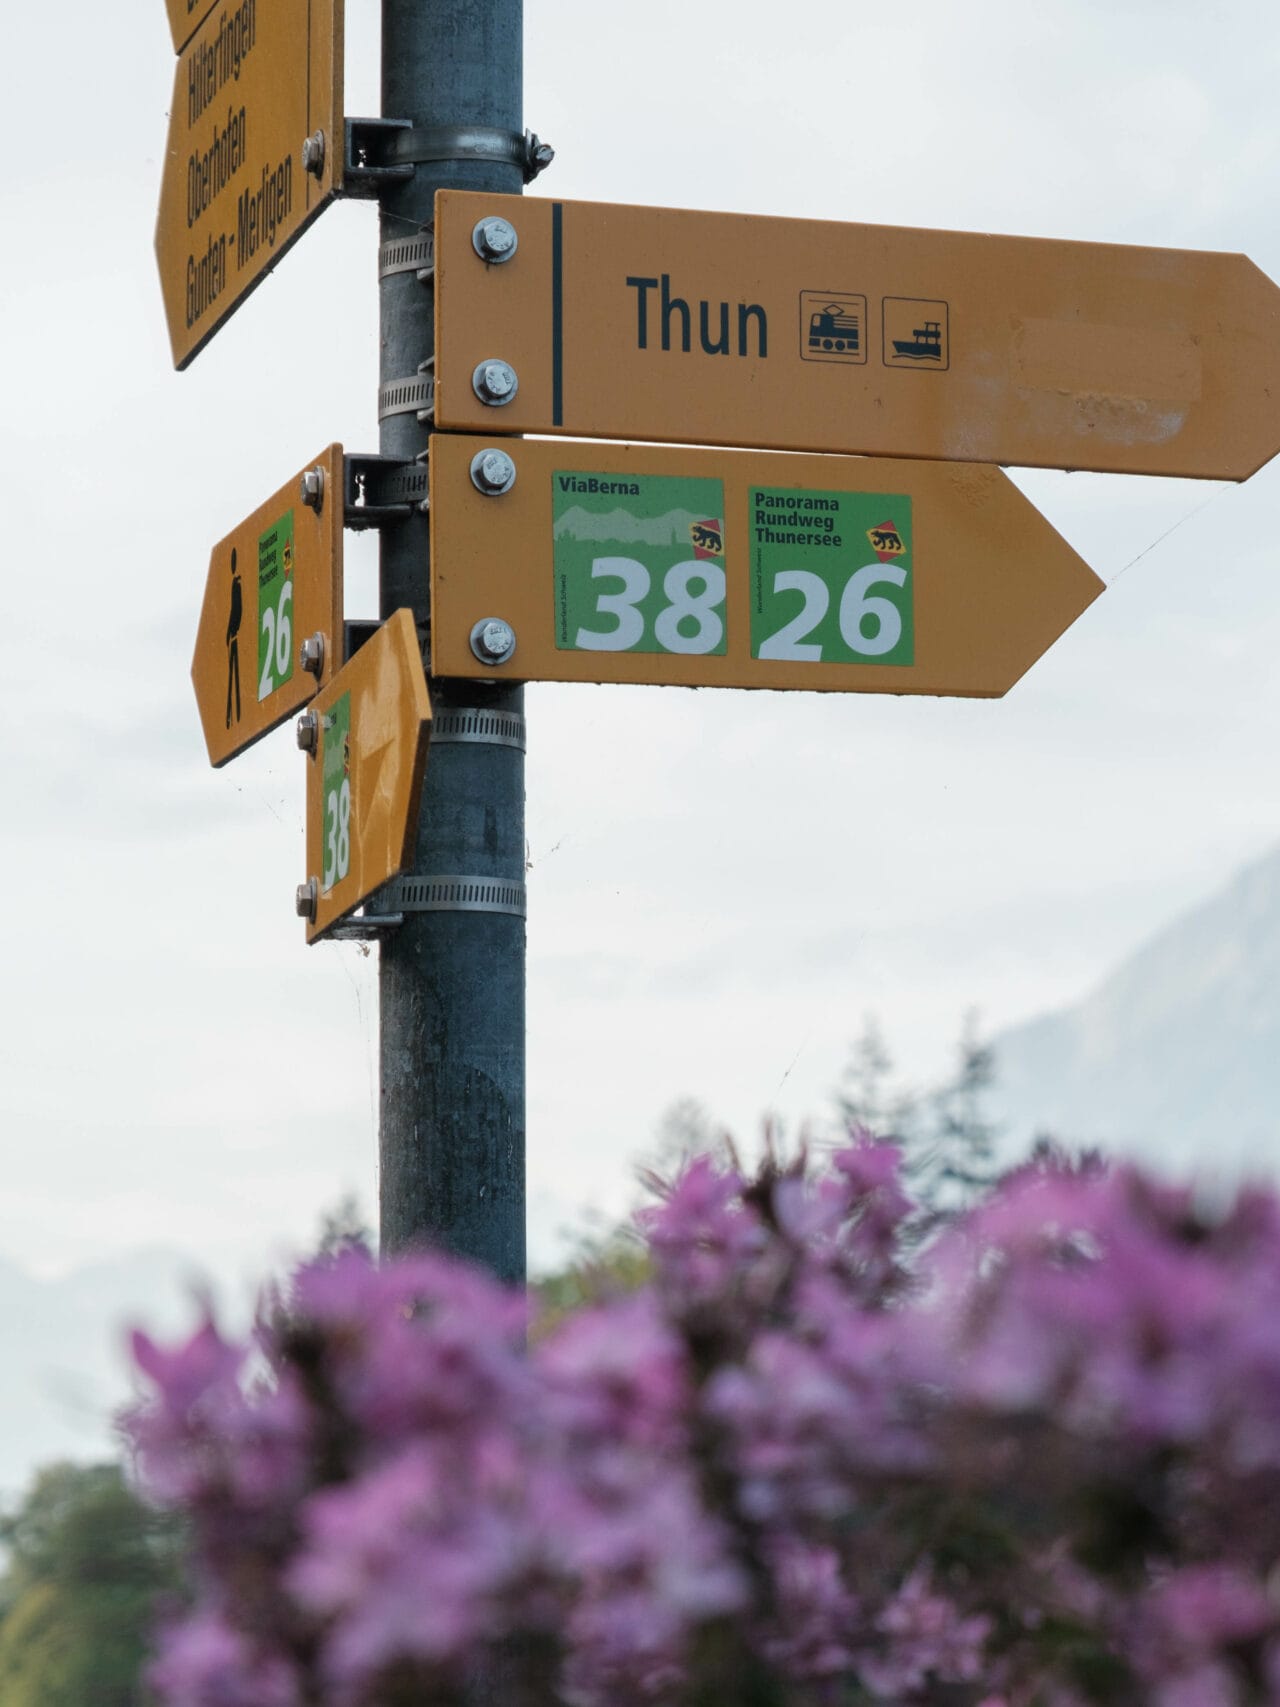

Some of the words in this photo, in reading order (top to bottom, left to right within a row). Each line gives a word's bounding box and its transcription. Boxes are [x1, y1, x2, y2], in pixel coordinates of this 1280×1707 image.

[187, 0, 256, 130] Hilterfingen
[187, 105, 246, 229] Oberhofen
[186, 232, 226, 330] Gunten
[237, 154, 292, 272] Merligen
[626, 274, 769, 358] Thun
[559, 476, 640, 496] ViaBerna
[755, 493, 839, 511] Panorama
[755, 511, 834, 532] Rundweg
[755, 528, 842, 547] Thunersee
[258, 580, 292, 701] 26
[575, 556, 726, 654] 38
[758, 563, 907, 662] 26
[324, 778, 350, 890] 38
